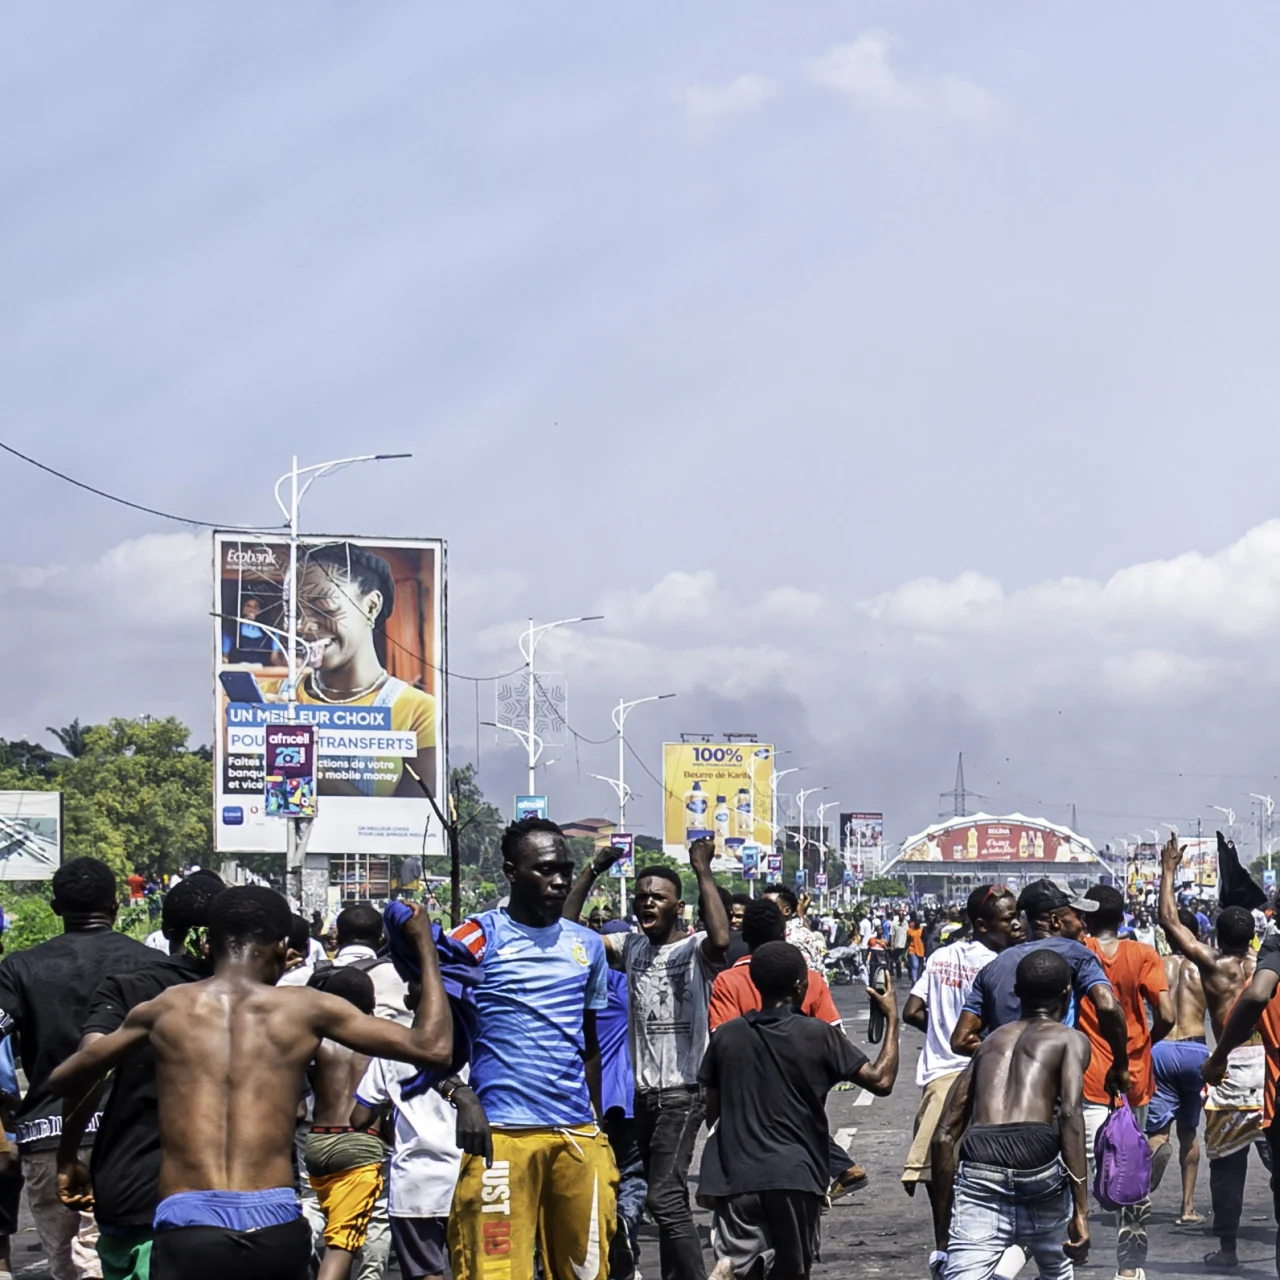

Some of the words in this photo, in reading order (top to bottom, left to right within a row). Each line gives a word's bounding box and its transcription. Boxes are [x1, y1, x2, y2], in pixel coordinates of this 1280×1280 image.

[227, 548, 277, 564] Ecobank
[230, 709, 250, 722] UN
[333, 713, 385, 725] CHOIX
[231, 734, 265, 746] POU
[319, 737, 414, 750] TRANSFERTS
[228, 757, 260, 766] Faites
[317, 760, 349, 769] ctions
[351, 760, 364, 769] de
[367, 761, 395, 769] votre
[692, 747, 744, 763] 100%
[325, 771, 361, 780] mobile
[363, 774, 399, 783] money
[684, 770, 713, 779] Beurre
[716, 770, 726, 779] de
[228, 781, 240, 789] et
[481, 1156, 511, 1216] JUST
[482, 1221, 512, 1256] DO
